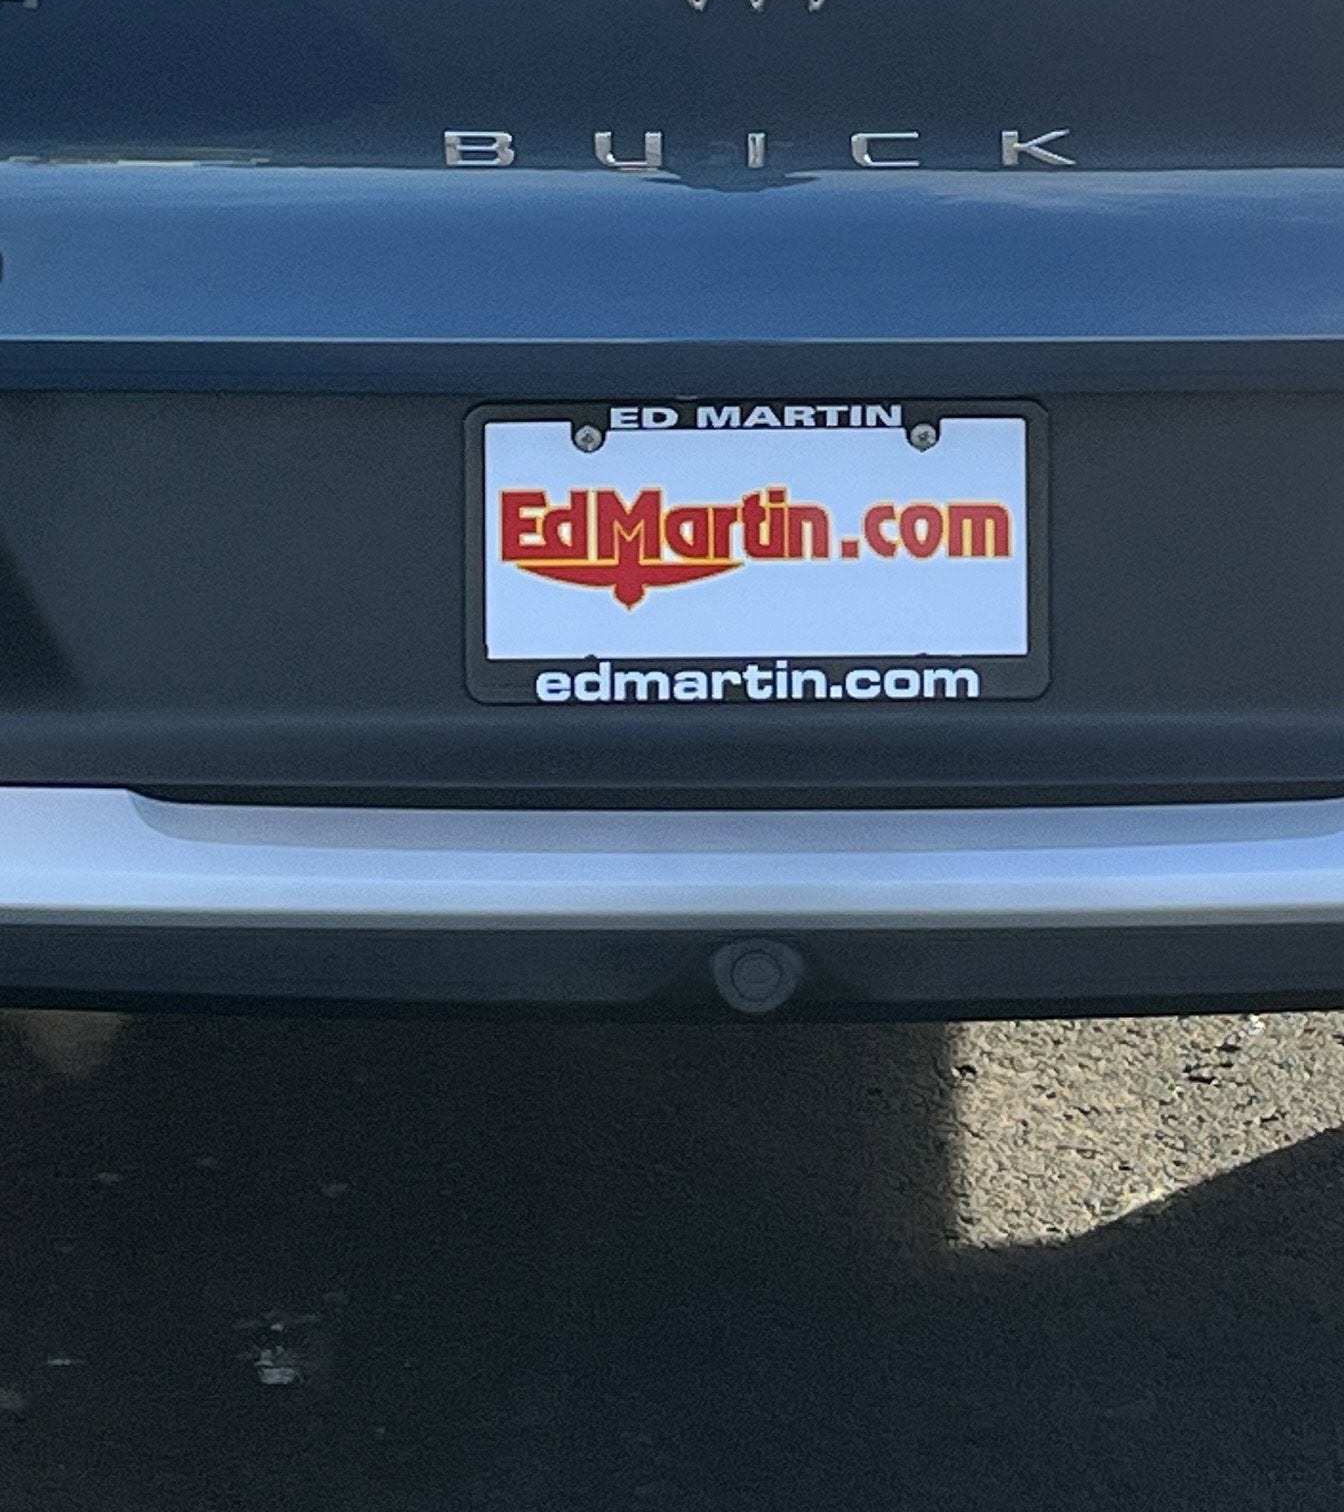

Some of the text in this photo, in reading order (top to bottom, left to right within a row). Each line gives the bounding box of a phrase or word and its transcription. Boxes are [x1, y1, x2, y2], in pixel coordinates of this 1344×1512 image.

[444, 129, 1078, 168] BUICK
[609, 405, 902, 429] ED MARTIN
[499, 486, 1013, 565] EdMartin.com
[535, 660, 981, 702] edmartin.com
